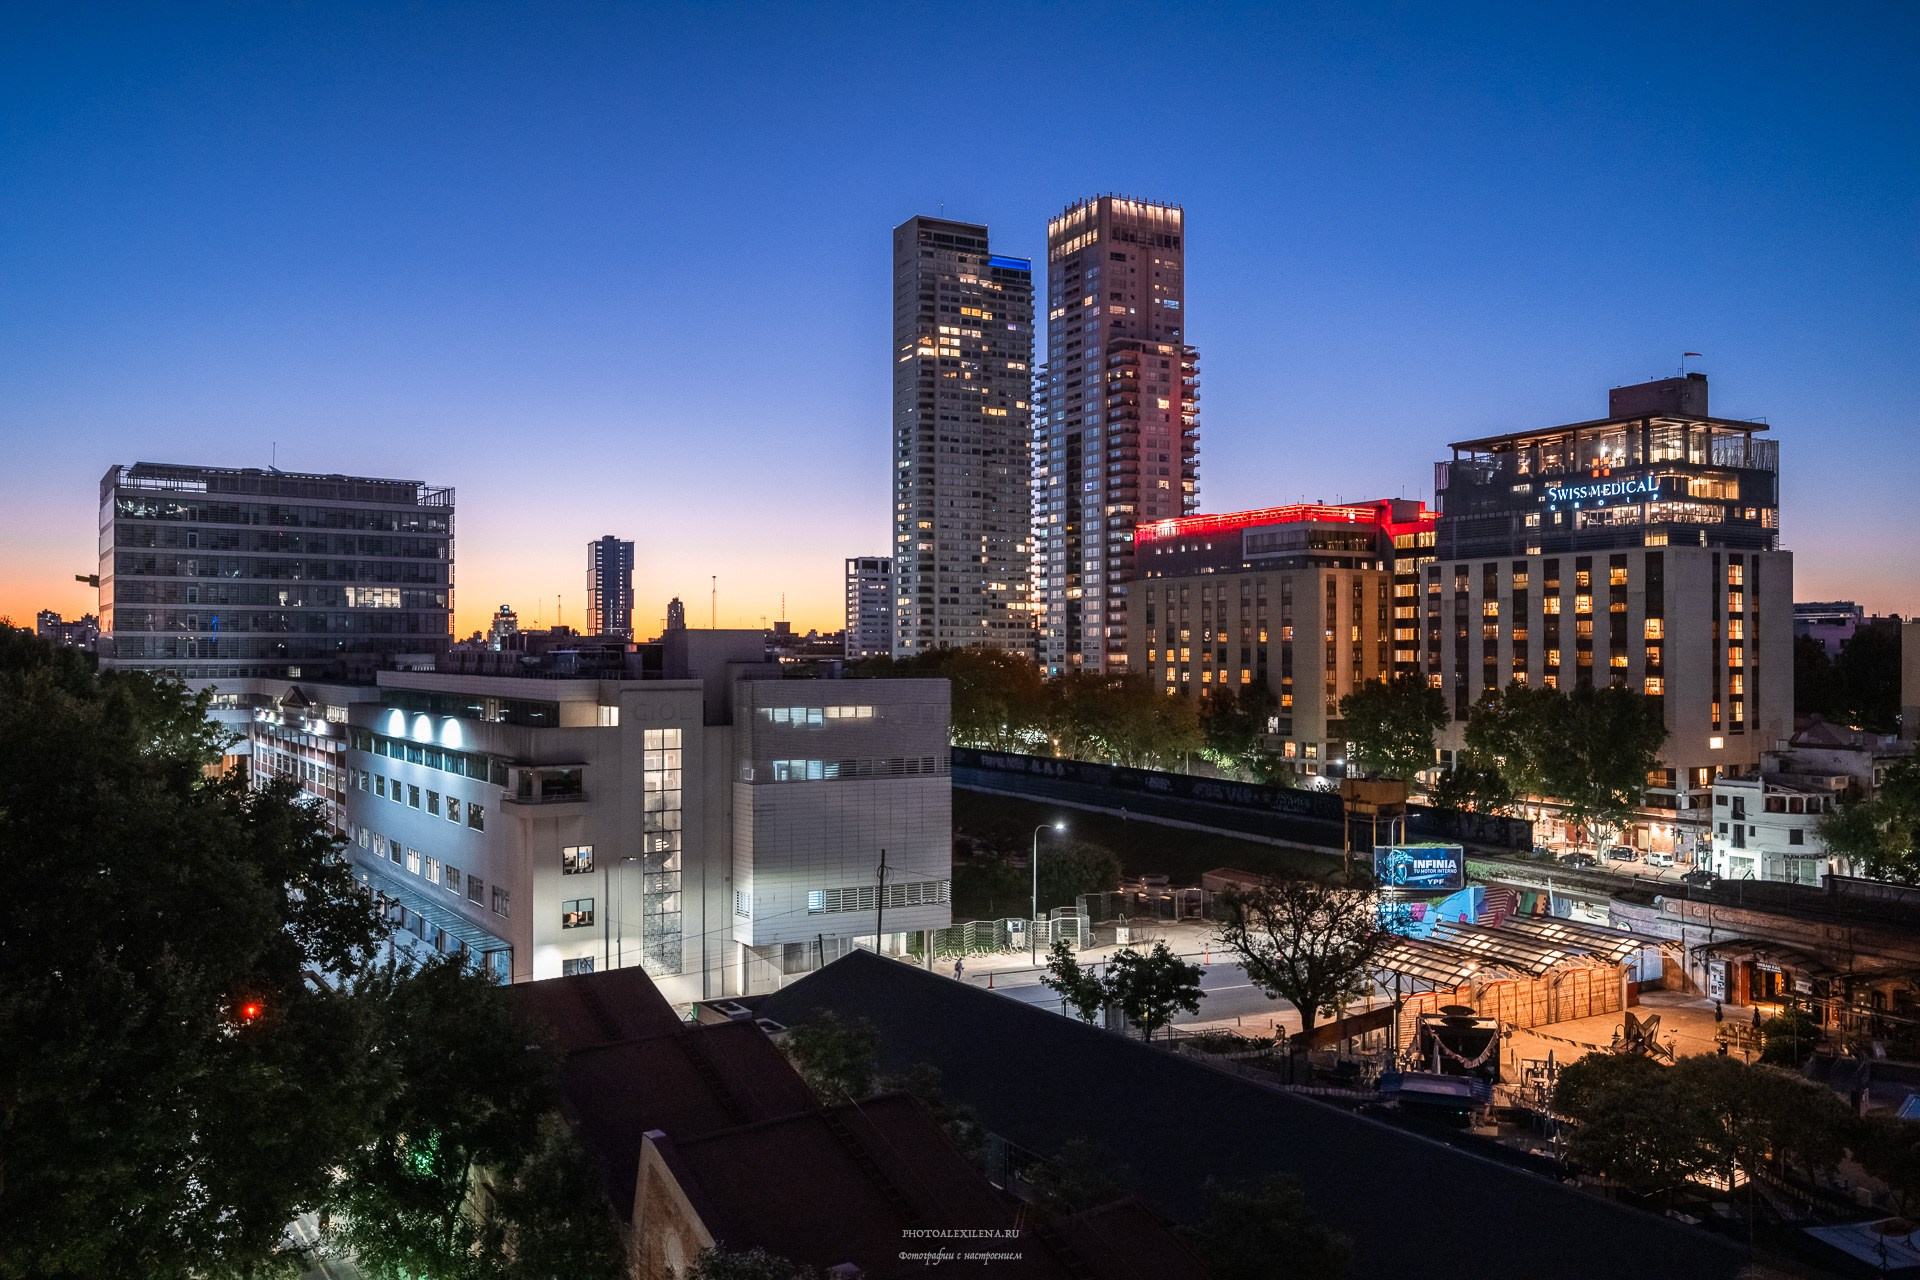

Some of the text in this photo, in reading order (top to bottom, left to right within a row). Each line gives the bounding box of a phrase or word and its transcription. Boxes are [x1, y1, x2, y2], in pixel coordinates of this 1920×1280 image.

[1548, 476, 1659, 501] SWISS MEDICAL
[1413, 859, 1457, 869] INFINIA
